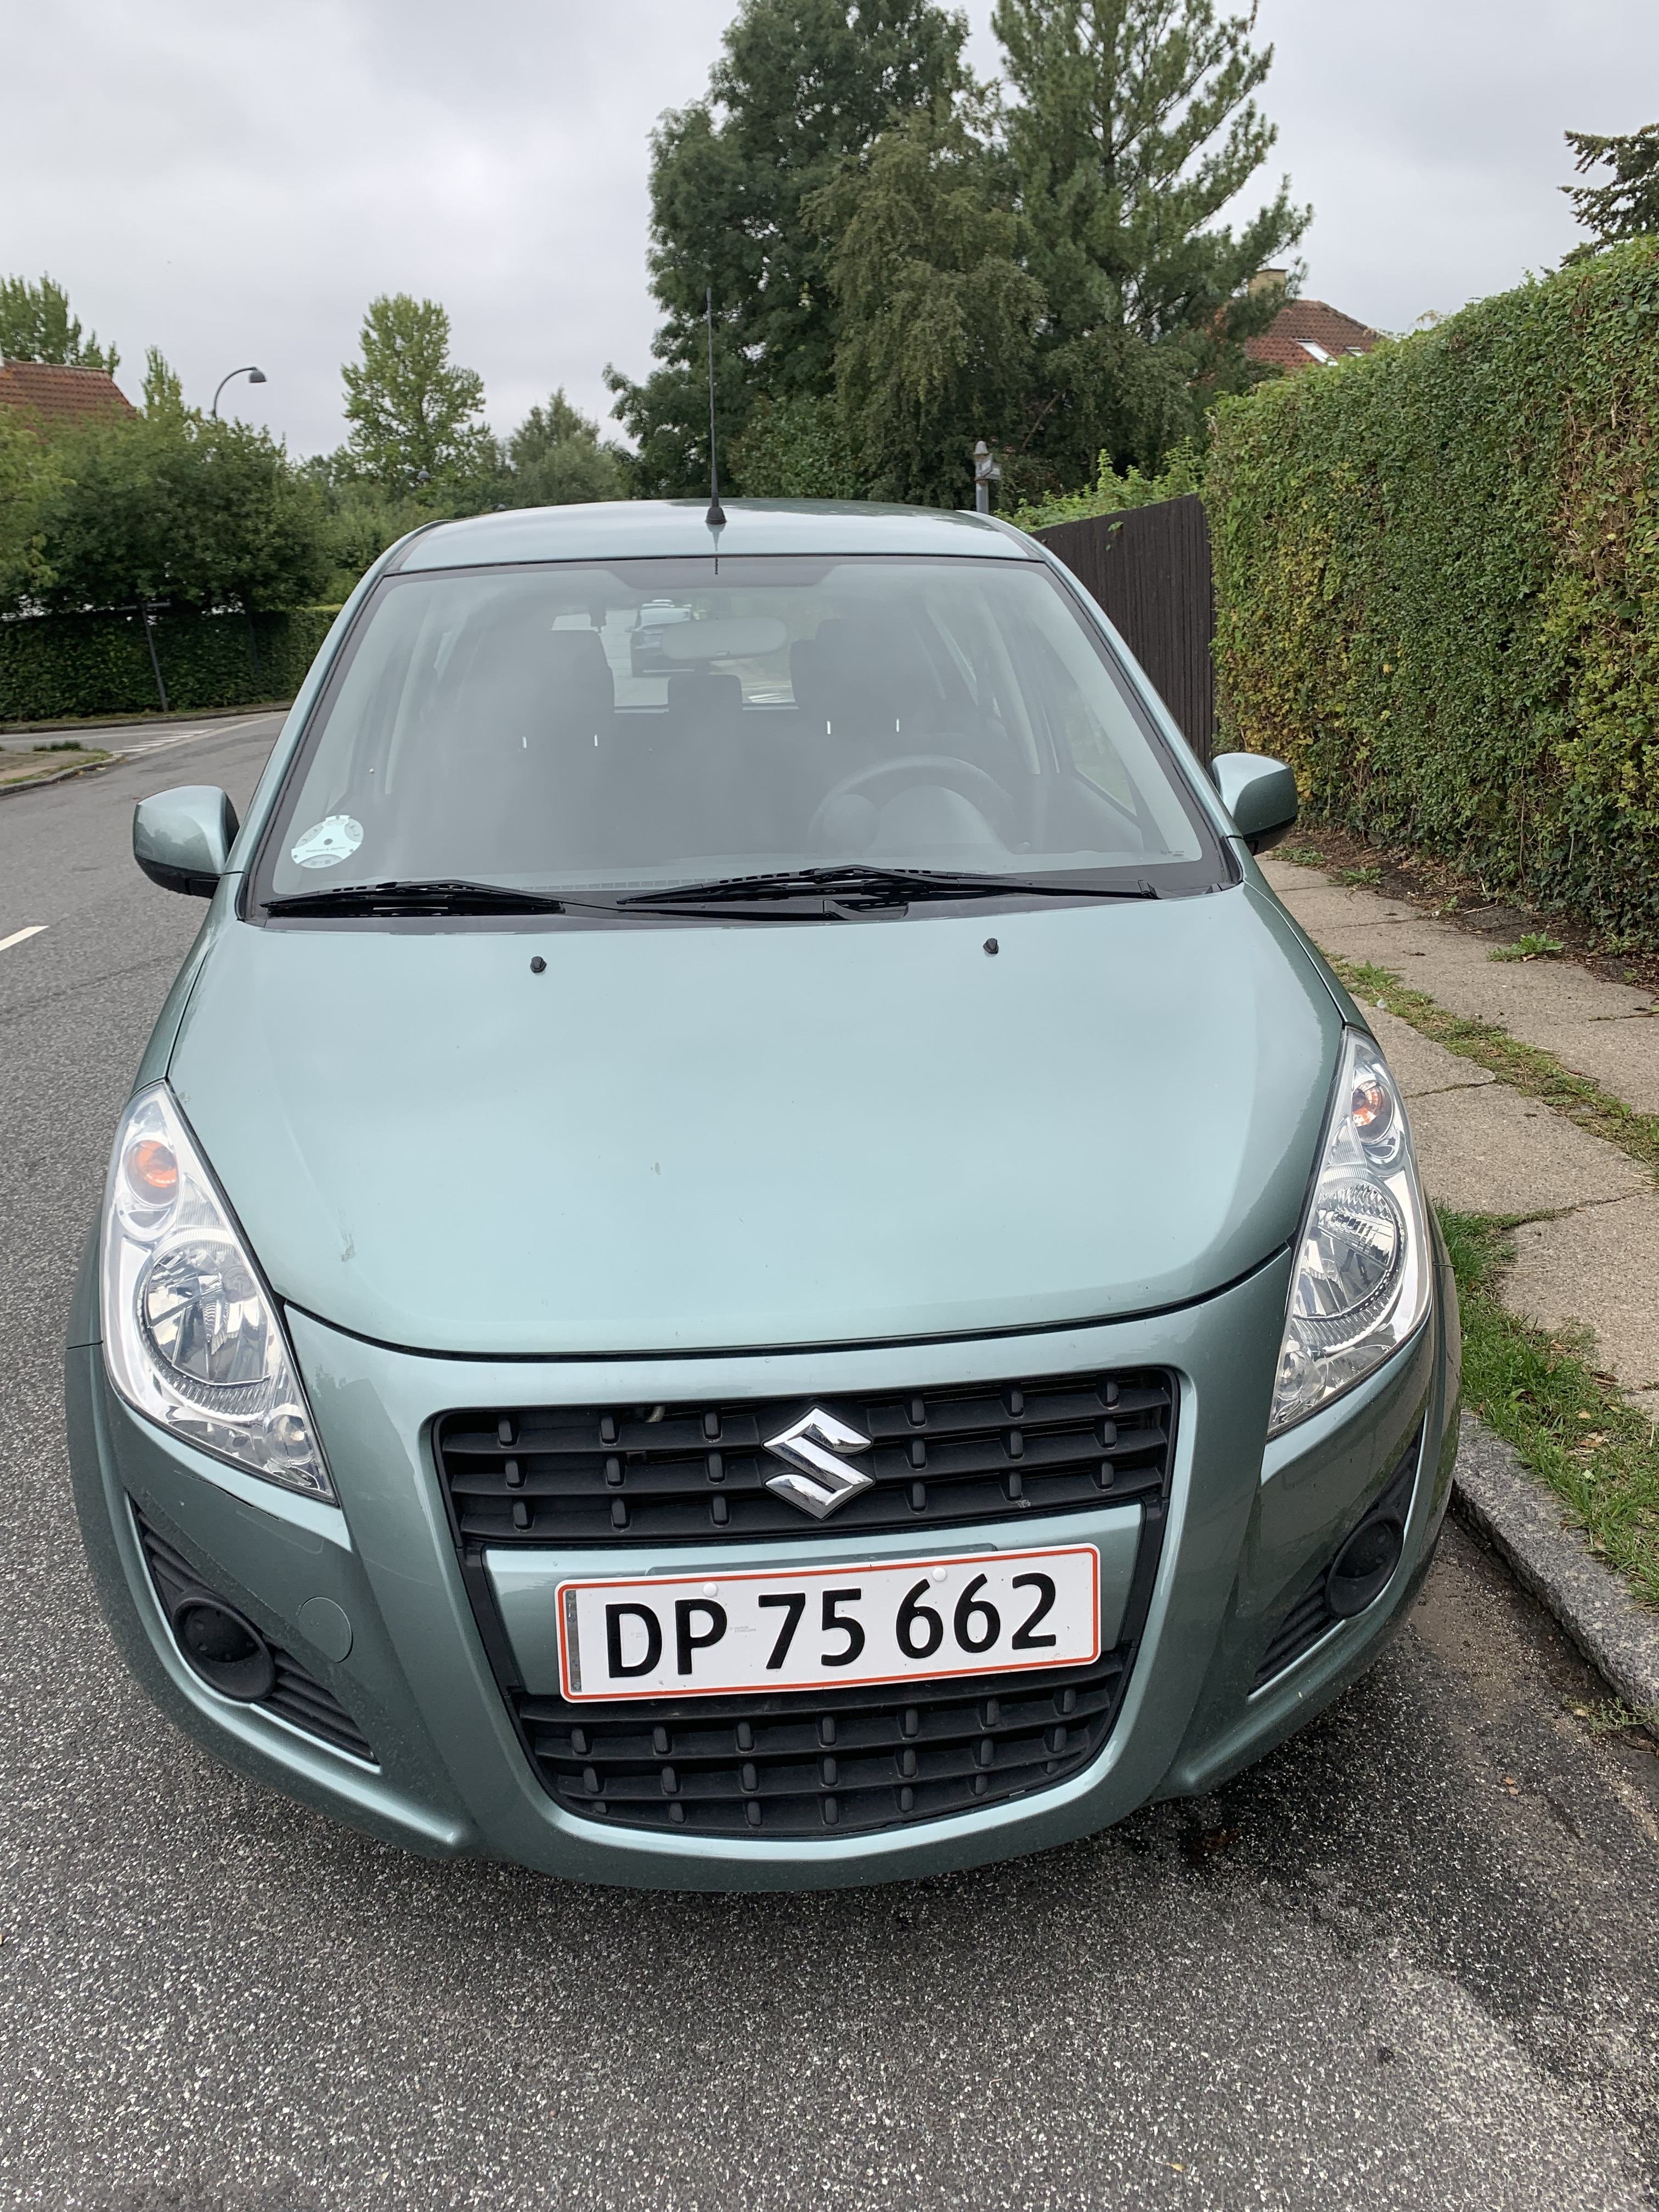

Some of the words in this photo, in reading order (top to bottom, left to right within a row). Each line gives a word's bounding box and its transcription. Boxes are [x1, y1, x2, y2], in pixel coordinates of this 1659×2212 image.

[605, 1599, 728, 1679] DP
[758, 1588, 865, 1670] 75
[896, 1572, 1057, 1660] 662
